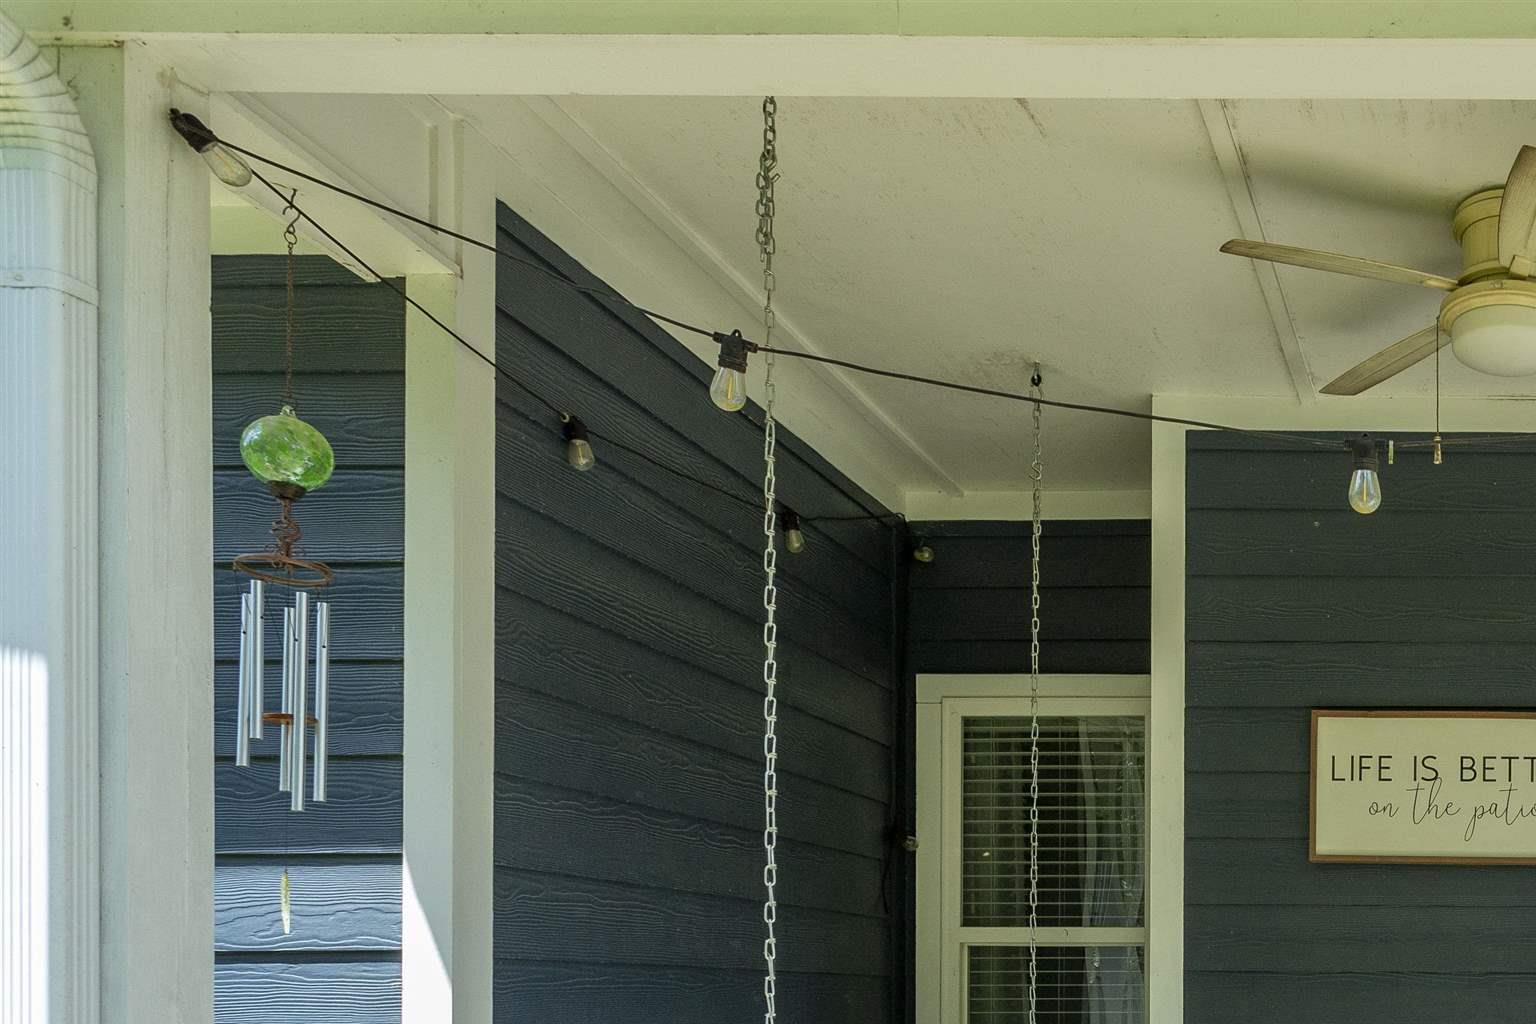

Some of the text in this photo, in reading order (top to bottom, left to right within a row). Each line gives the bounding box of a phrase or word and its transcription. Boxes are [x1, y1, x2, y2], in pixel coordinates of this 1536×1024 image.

[1331, 755, 1393, 782] LIFE
[1413, 755, 1438, 782] IS
[1368, 800, 1400, 817] on
[1406, 777, 1461, 824] the
